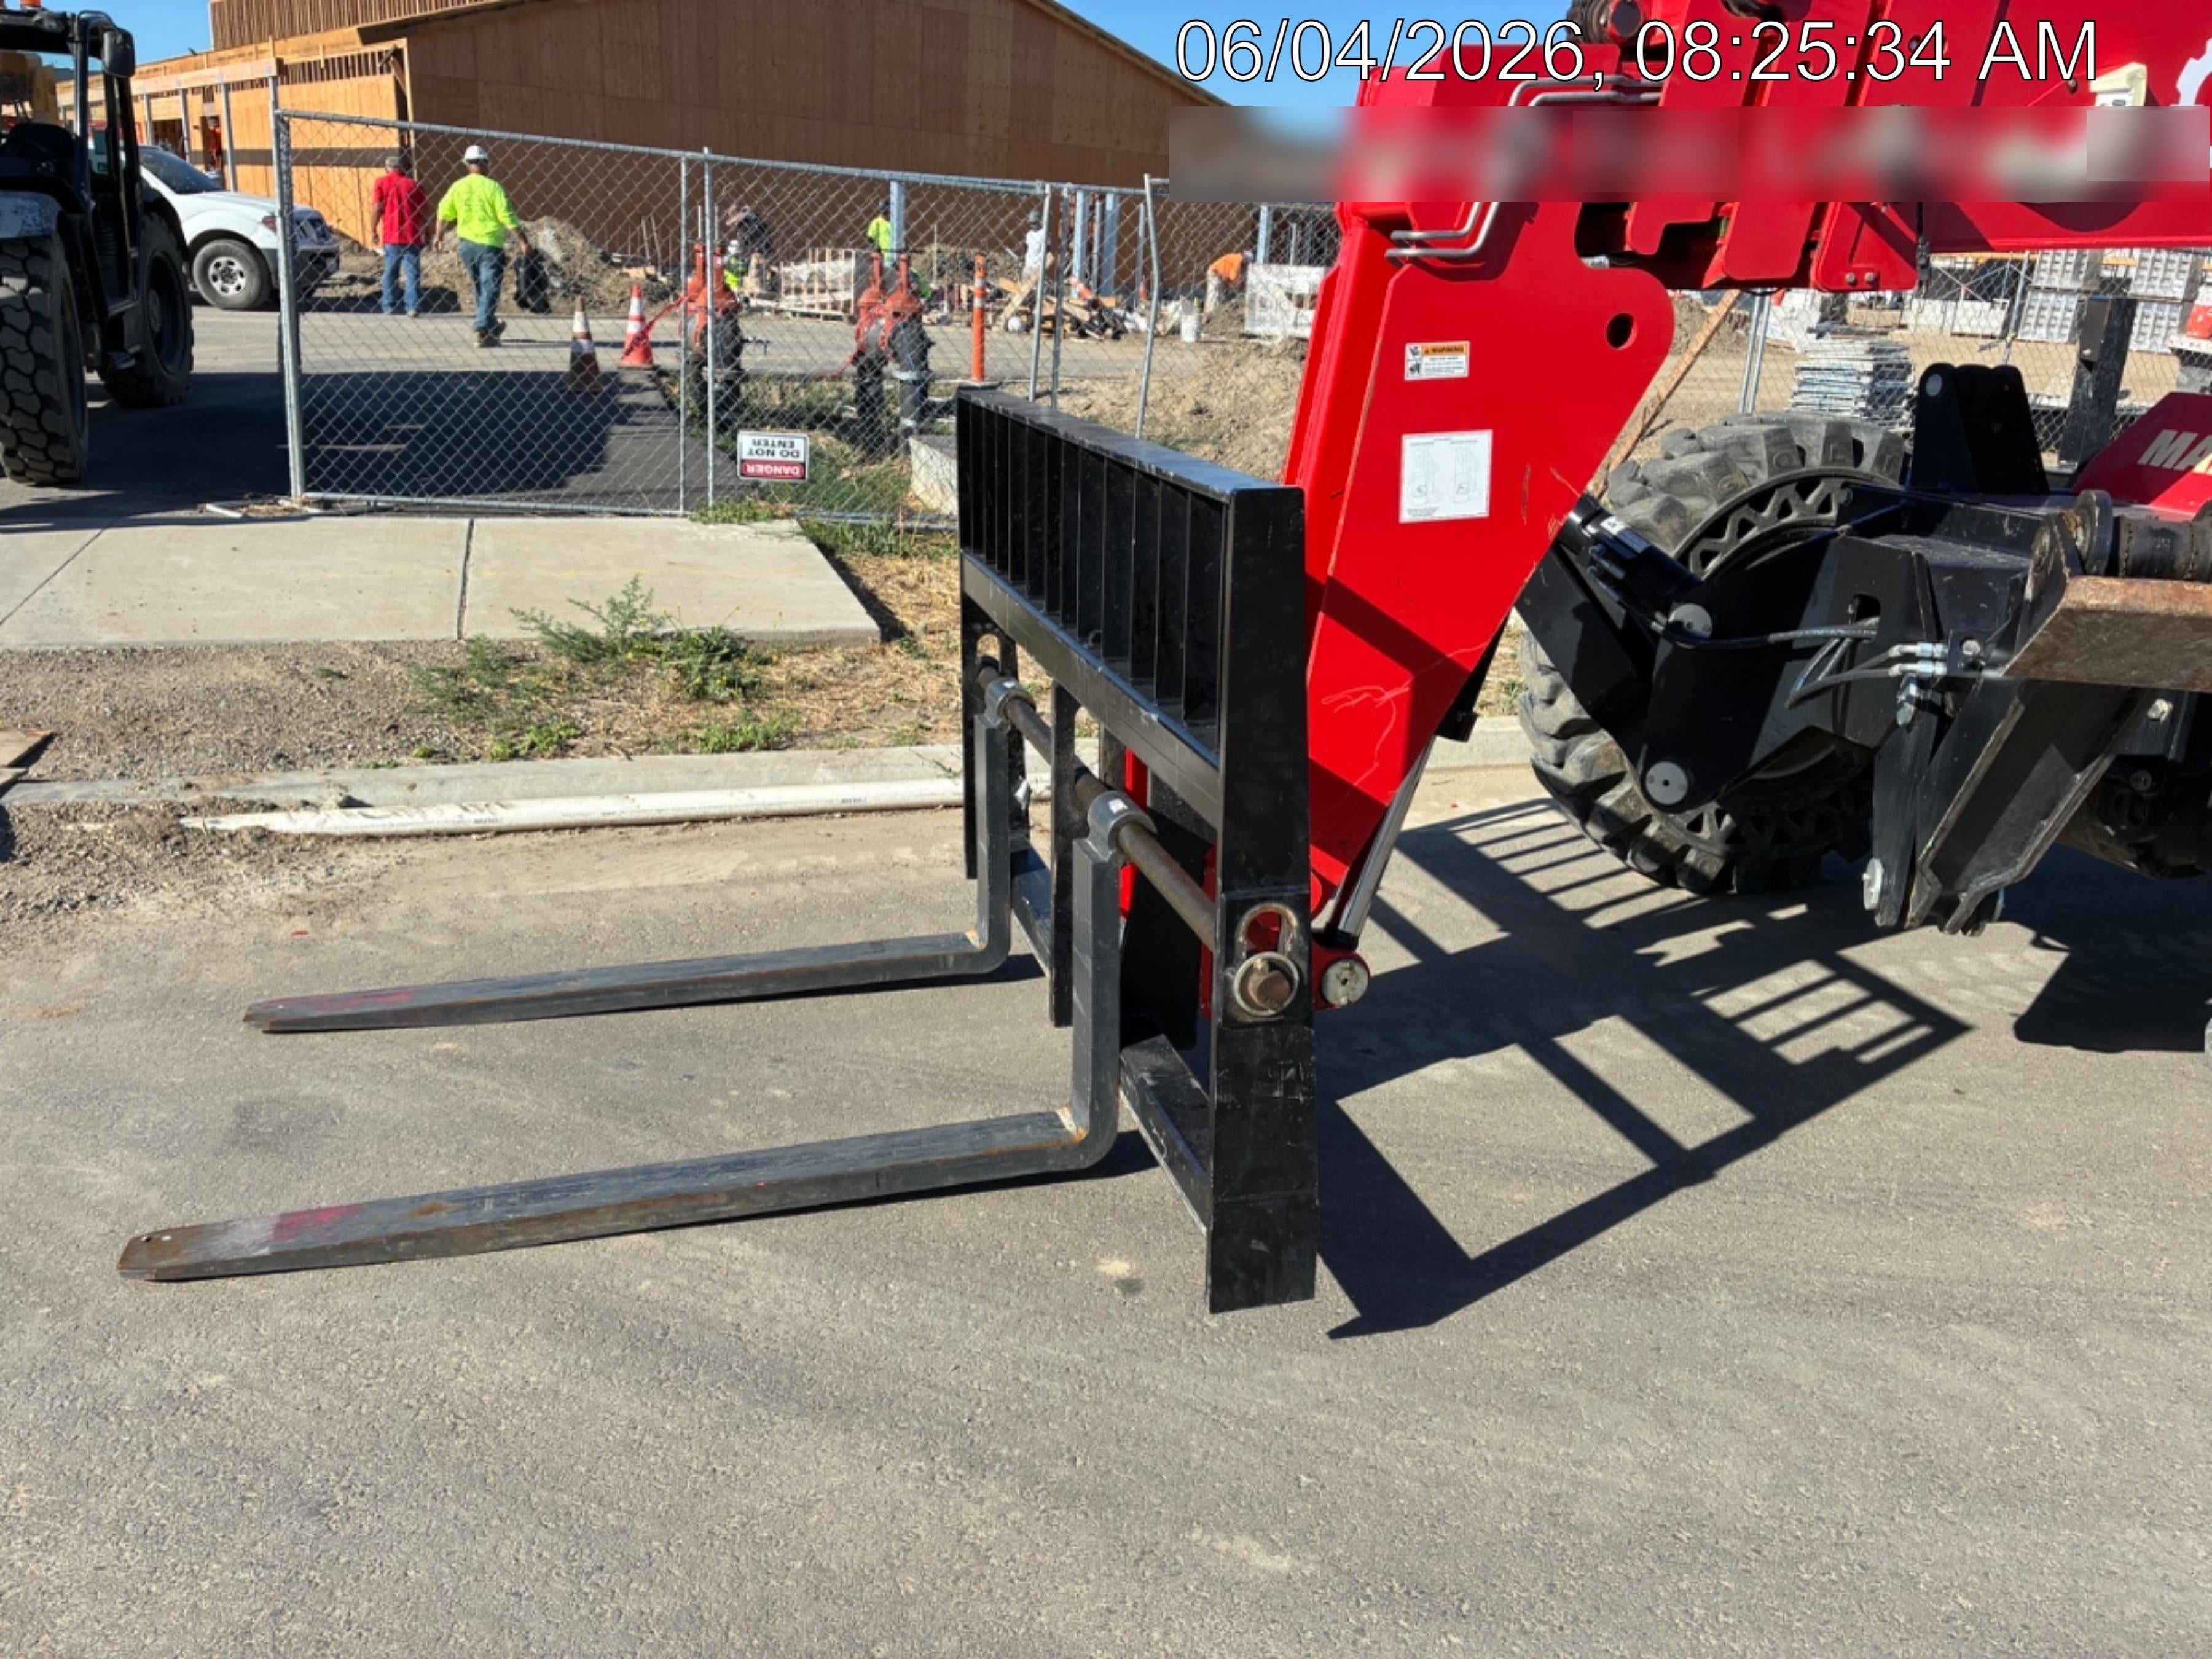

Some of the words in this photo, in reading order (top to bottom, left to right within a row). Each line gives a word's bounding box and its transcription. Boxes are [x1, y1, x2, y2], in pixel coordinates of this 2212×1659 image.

[751, 438, 795, 448] ENTER
[748, 448, 775, 457] NOT
[779, 449, 800, 458] DO
[2137, 429, 2212, 476] MA
[745, 463, 799, 475] DANGER
